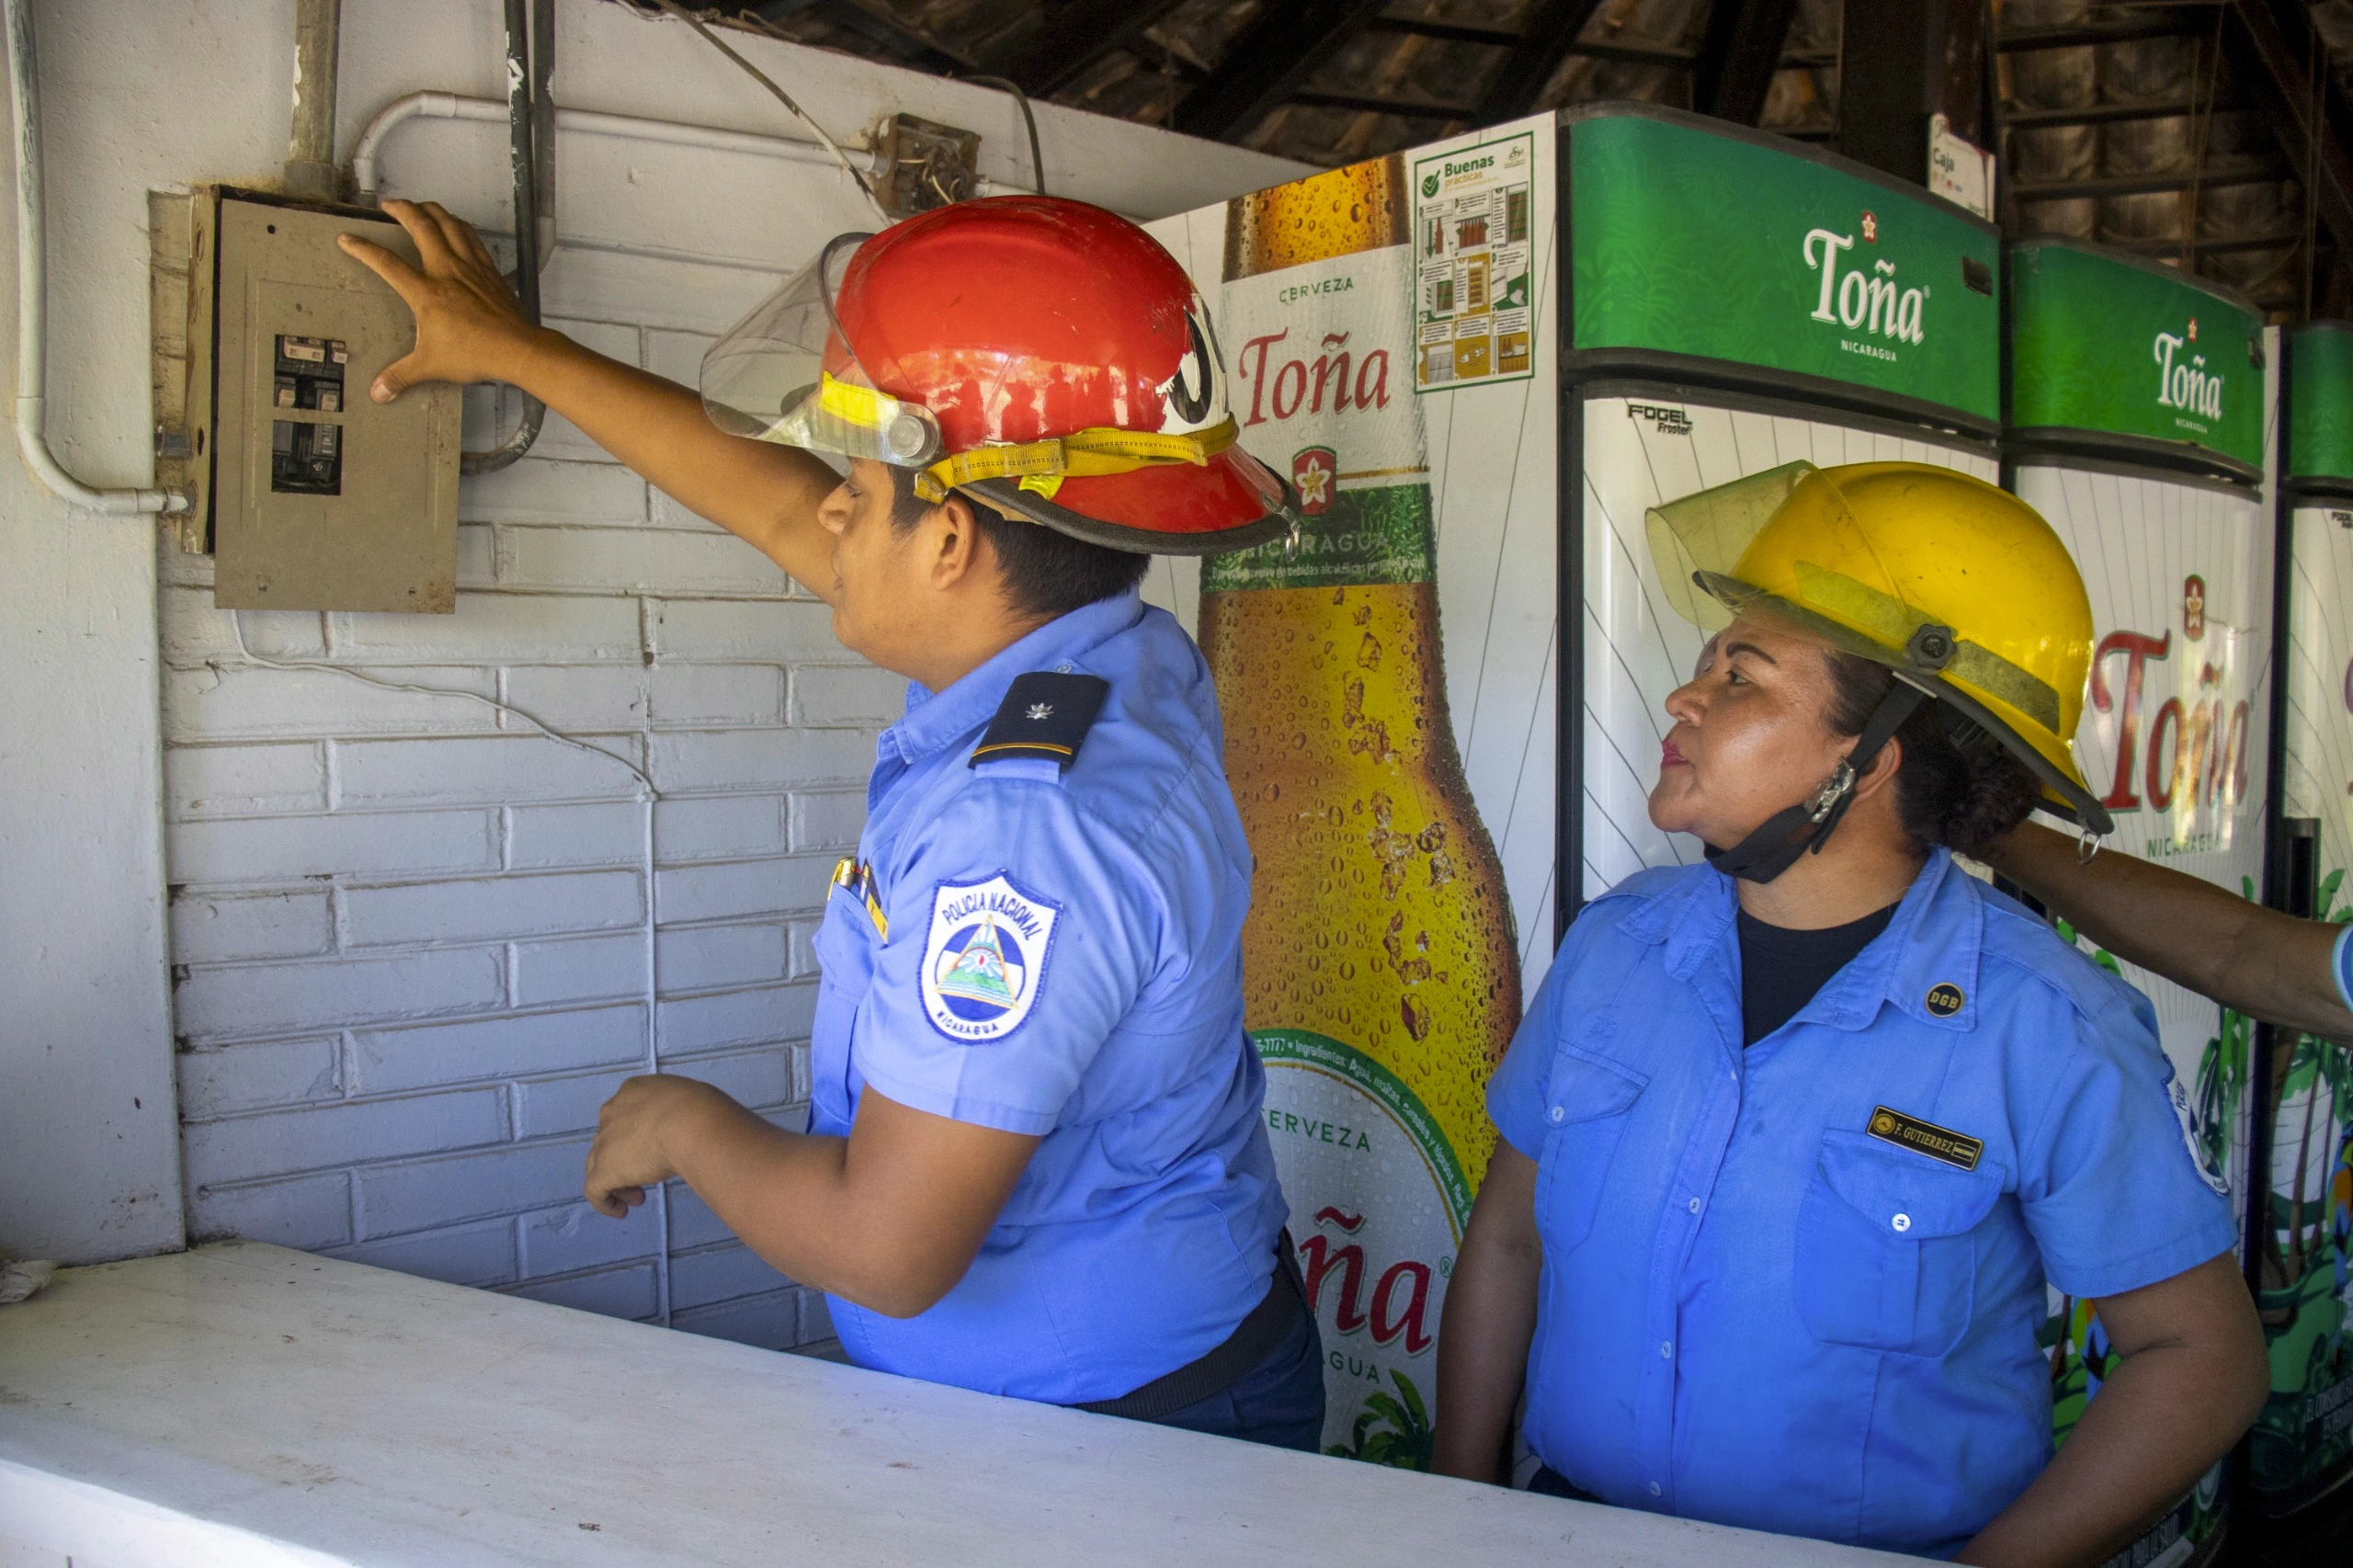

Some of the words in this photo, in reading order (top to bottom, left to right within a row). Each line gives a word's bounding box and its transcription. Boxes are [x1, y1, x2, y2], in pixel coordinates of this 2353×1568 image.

[1445, 155, 1495, 178] Buenas
[1445, 172, 1483, 189] prácticas
[1279, 278, 1354, 303] CERVEZA
[1803, 228, 1925, 347] Toña
[1841, 340, 1898, 363] NICARAGUA
[1239, 327, 1392, 427] Toña
[2154, 333, 2222, 421] Toña
[2176, 418, 2208, 435] NICARAGUA
[2091, 629, 2248, 814] Toña
[2147, 832, 2222, 858] NICARAGUA
[989, 892, 1042, 941] NACIONAL
[1929, 991, 1959, 1010] DGB
[936, 1009, 999, 1035] NICARAGUA
[1261, 1108, 1370, 1153] ERVEZA
[1904, 1126, 1955, 1154] GUTIERREZ
[1298, 1206, 1433, 1355] ña
